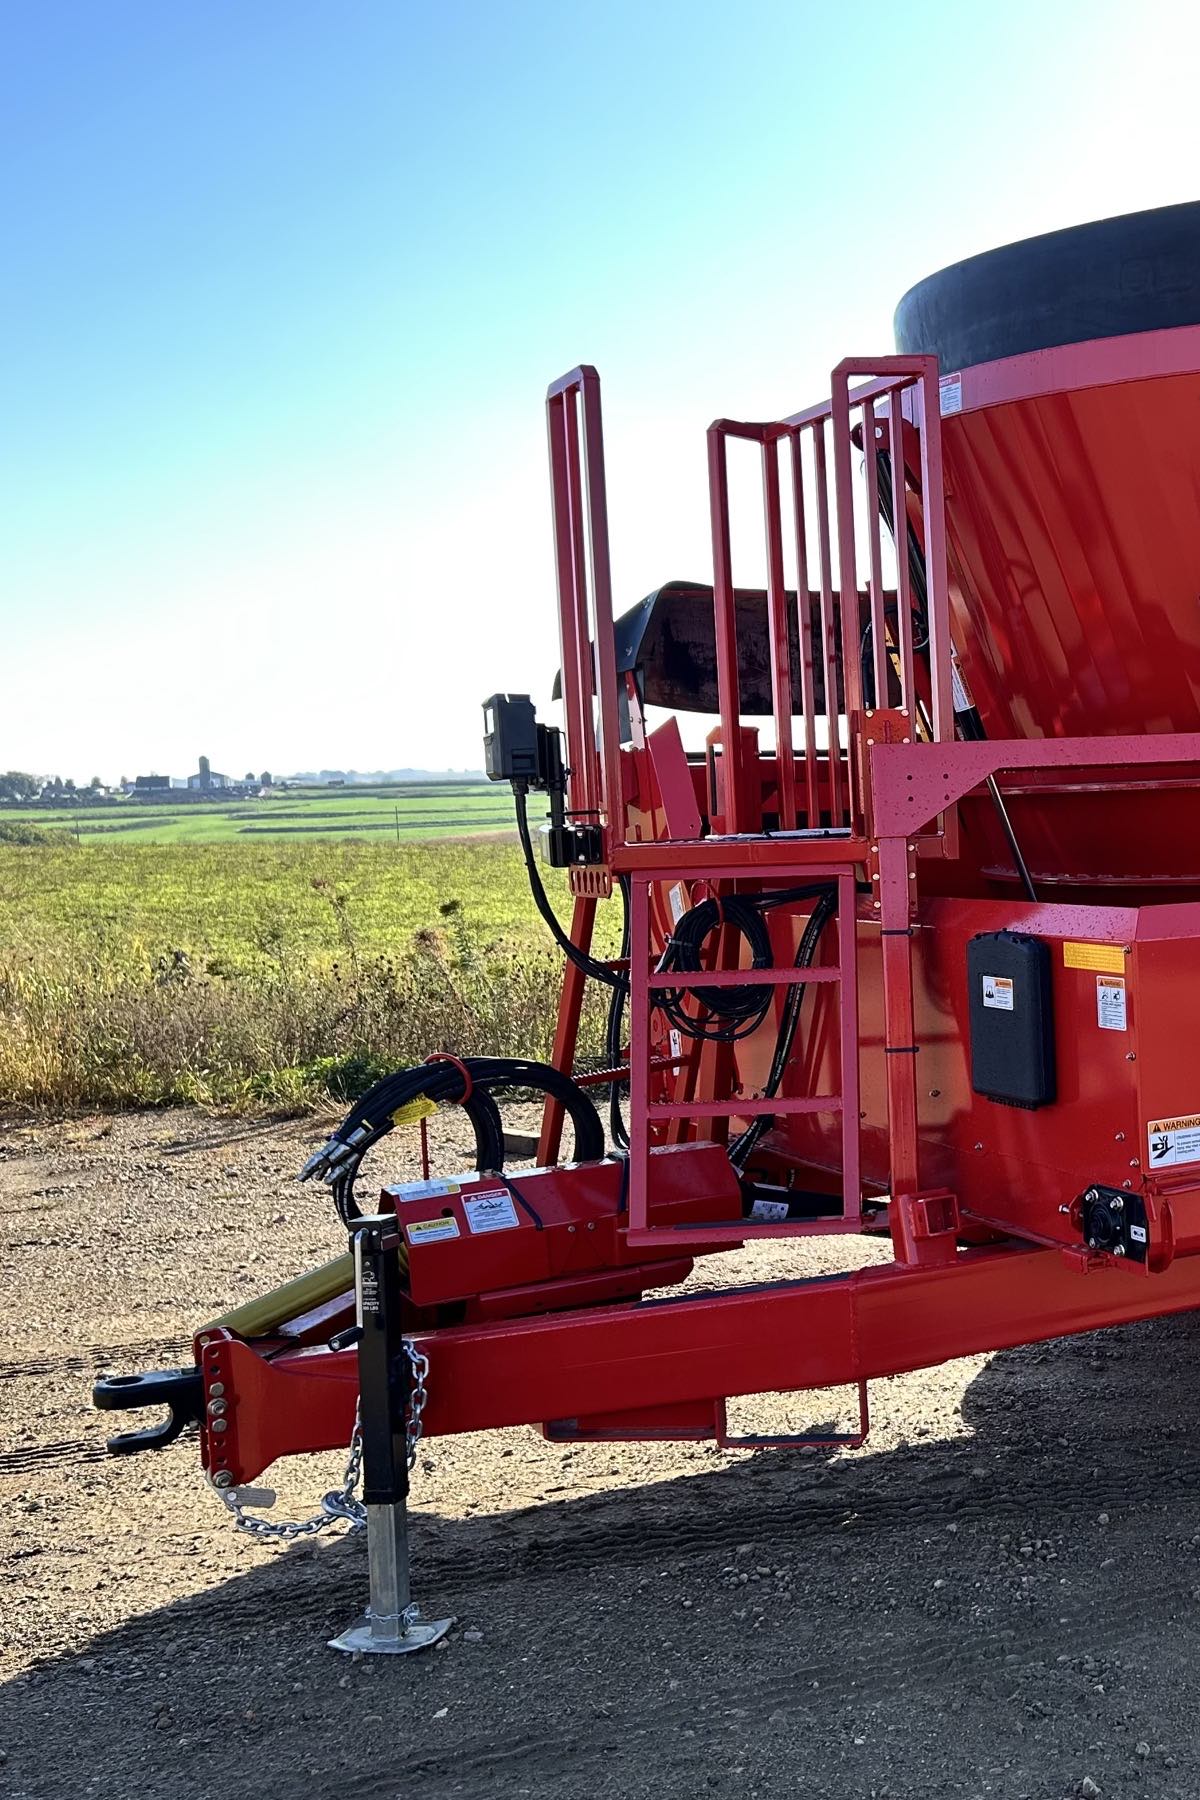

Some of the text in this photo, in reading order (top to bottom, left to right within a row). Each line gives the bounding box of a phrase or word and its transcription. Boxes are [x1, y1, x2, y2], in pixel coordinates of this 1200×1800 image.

[1163, 1117, 1200, 1130] WARNING
[477, 1191, 503, 1200] DANGER
[423, 1220, 450, 1229] CAUTION
